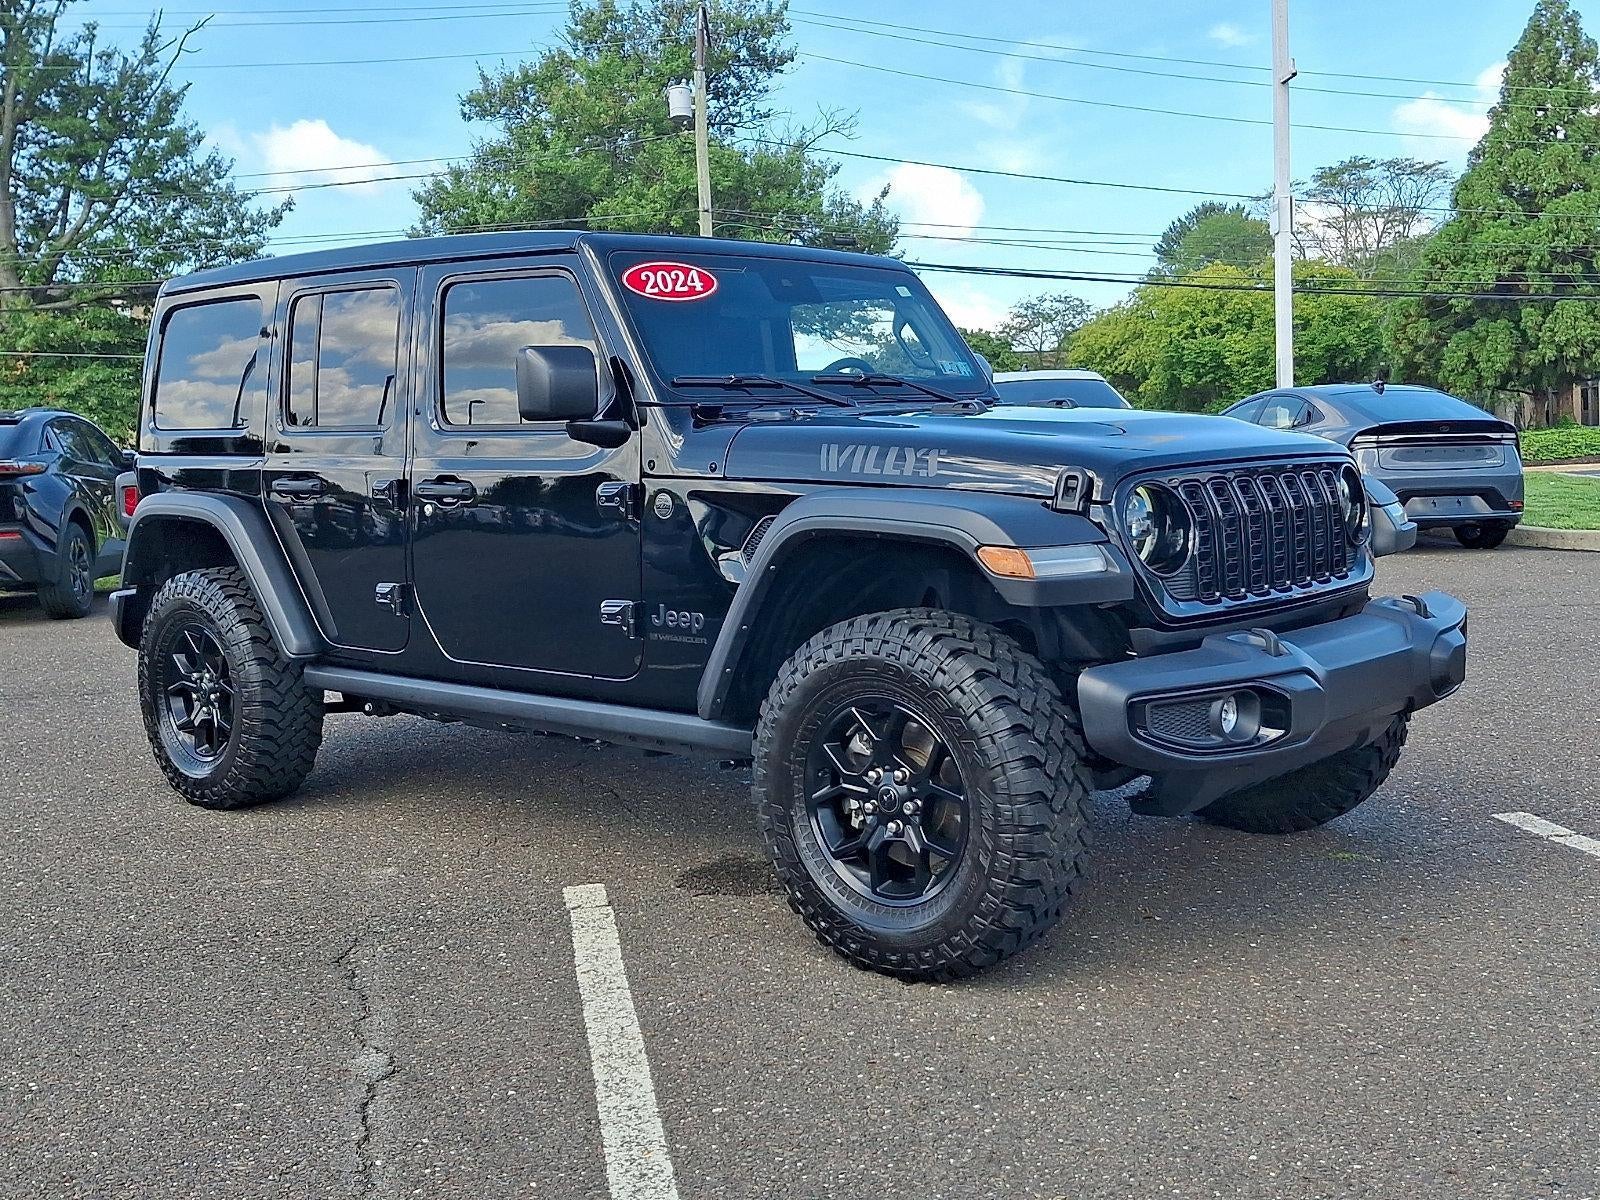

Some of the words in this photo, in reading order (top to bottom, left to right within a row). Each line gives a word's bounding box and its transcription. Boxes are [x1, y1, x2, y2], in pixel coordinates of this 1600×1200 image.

[640, 269, 704, 294] 2024
[820, 443, 948, 478] WILLYS
[651, 603, 705, 634] Jeep
